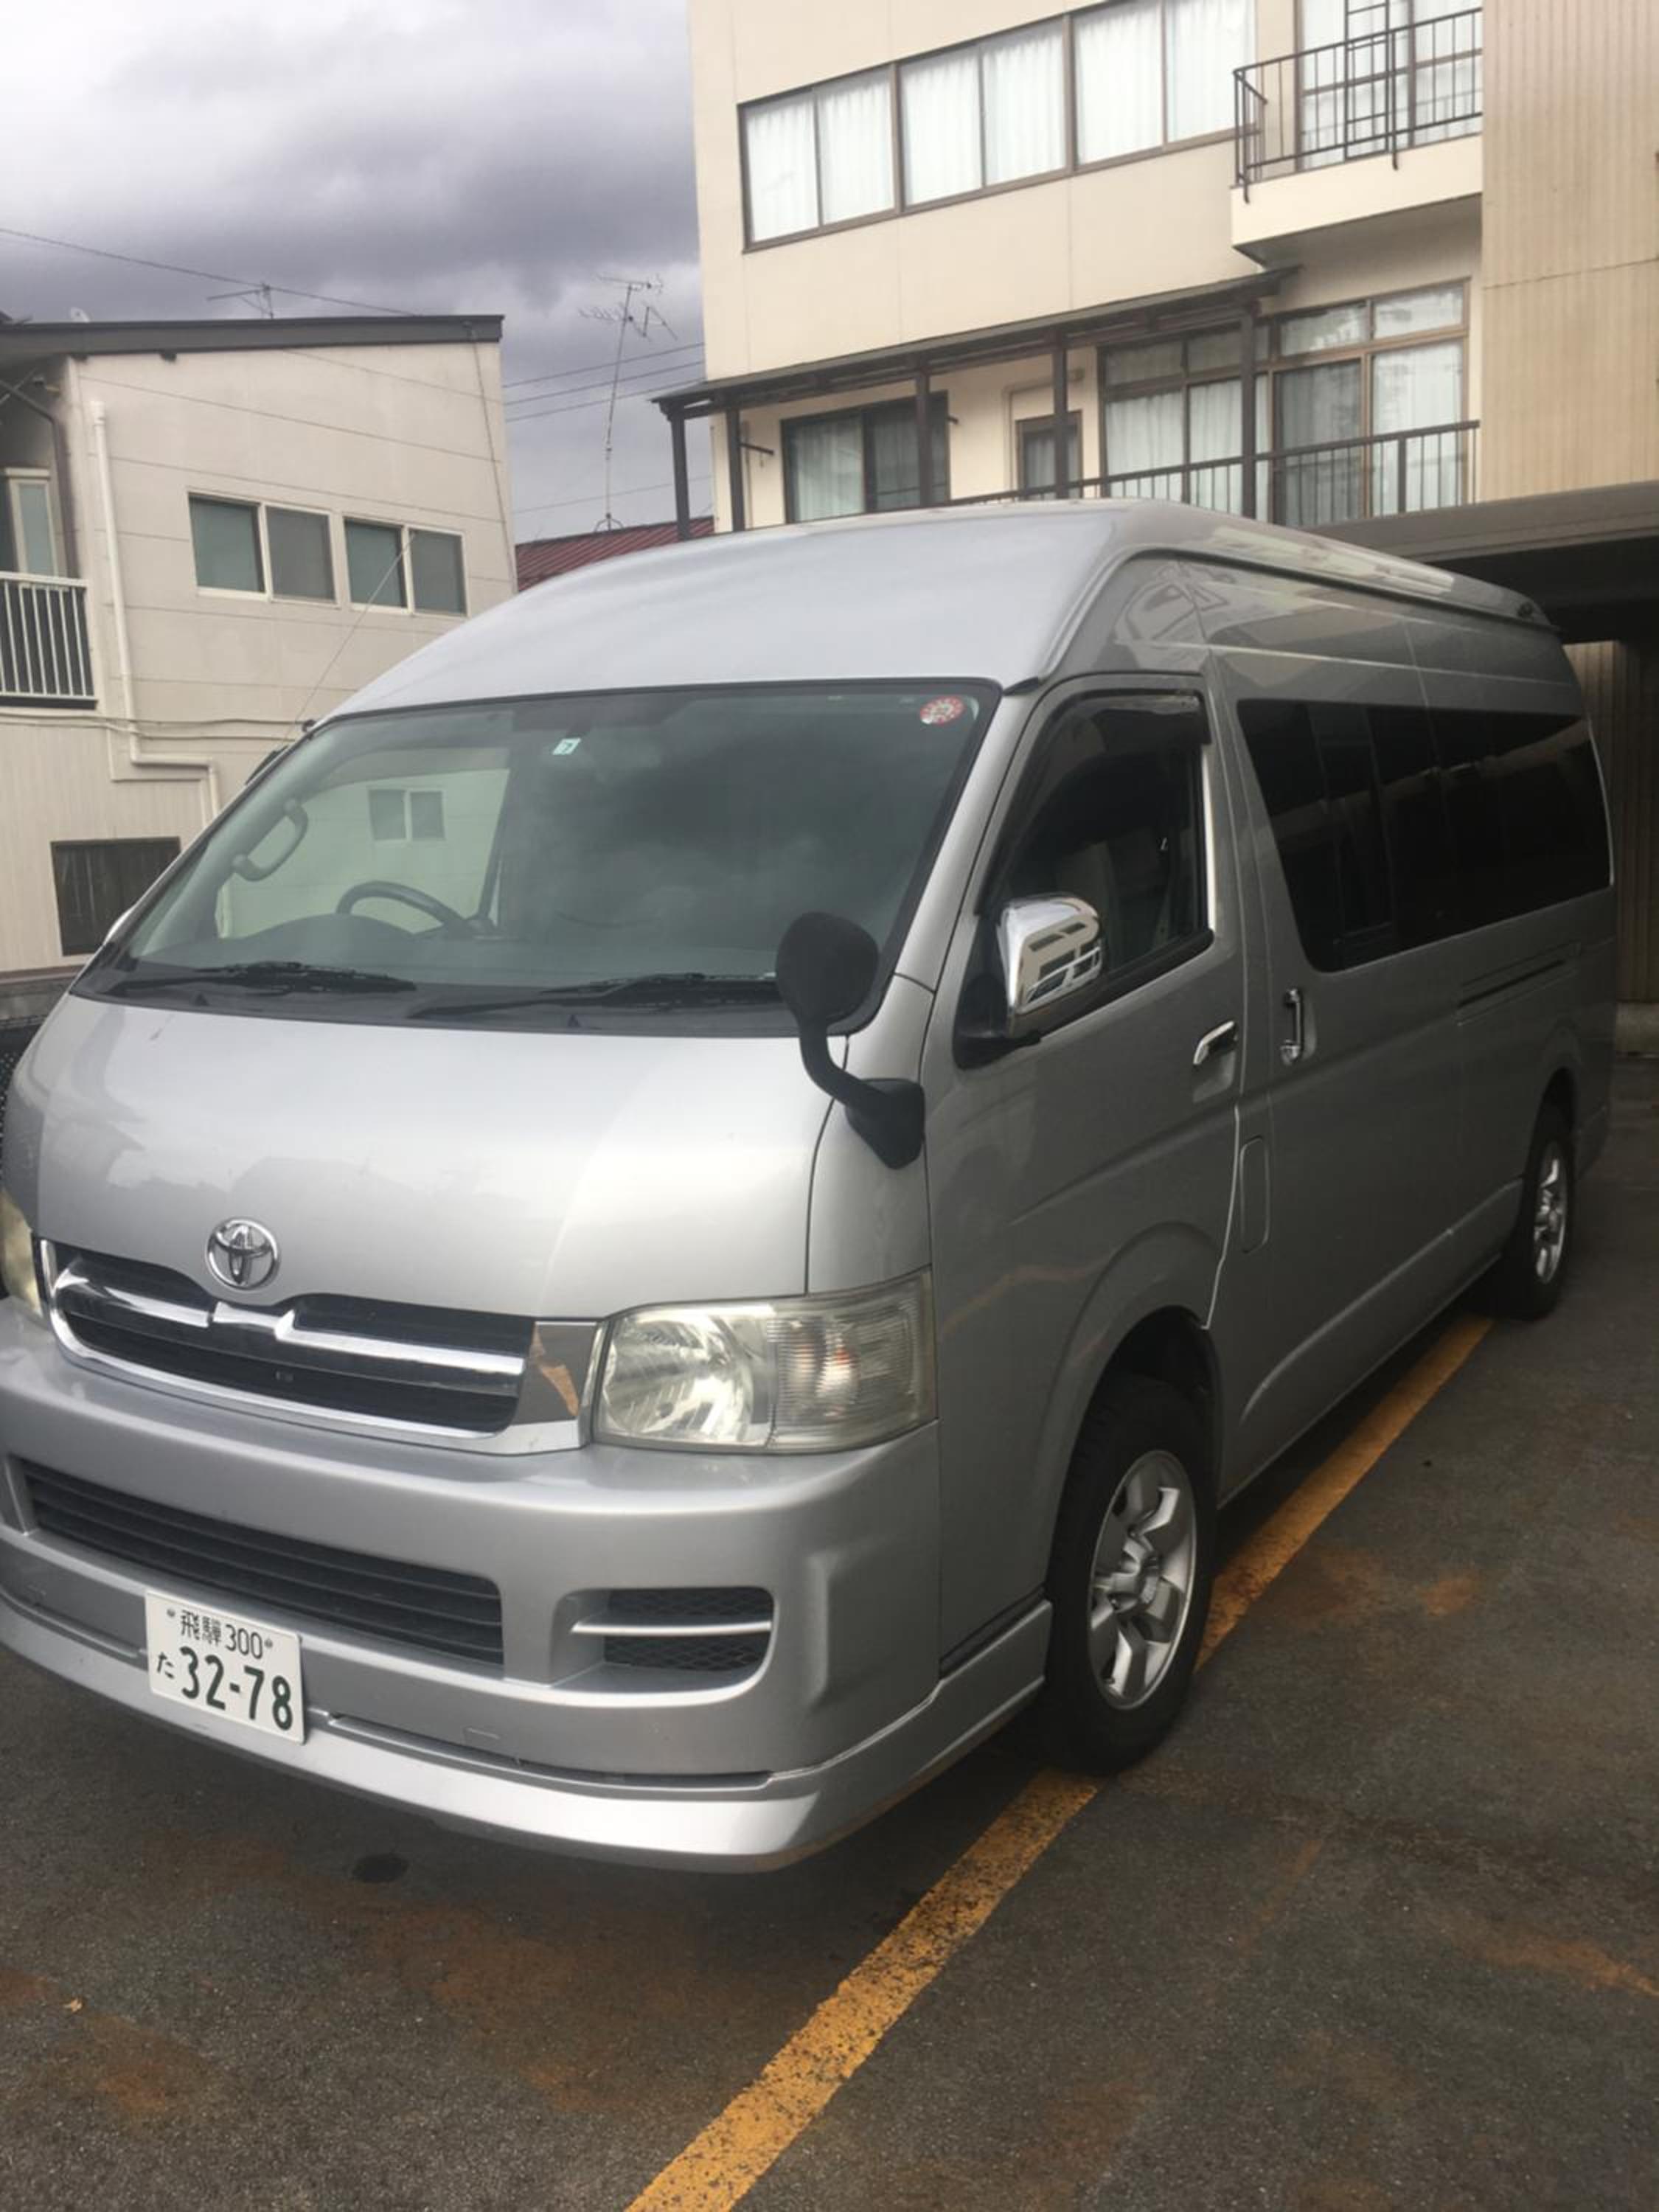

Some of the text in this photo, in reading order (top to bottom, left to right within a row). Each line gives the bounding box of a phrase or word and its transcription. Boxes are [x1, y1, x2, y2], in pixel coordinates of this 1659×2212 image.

[225, 1624, 263, 1660] 300
[156, 1646, 293, 1731] た 32-78
